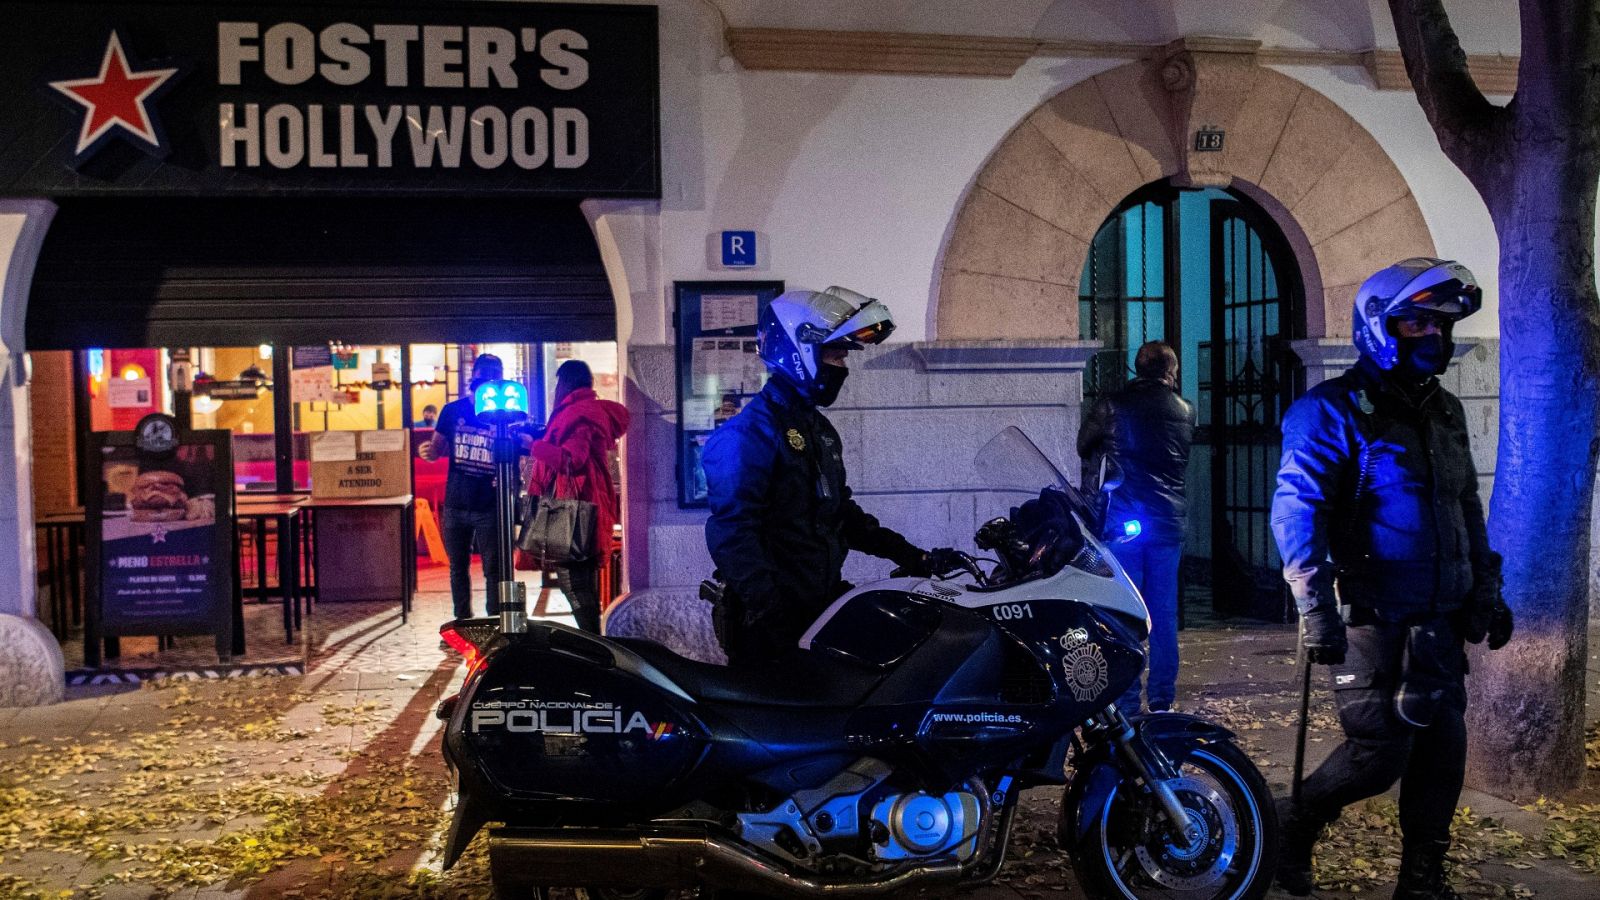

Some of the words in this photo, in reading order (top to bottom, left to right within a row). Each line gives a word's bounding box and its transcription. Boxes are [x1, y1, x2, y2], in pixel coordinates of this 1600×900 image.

[218, 21, 590, 91] FOSTER'S
[219, 103, 590, 170] HOLLYWOOD
[1201, 134, 1221, 148] 13
[731, 235, 746, 255] R
[792, 352, 805, 381] CNP
[347, 465, 353, 475] A
[355, 465, 373, 475] SER
[338, 479, 382, 488] ATENDIDO
[916, 589, 956, 602] HONDA
[472, 701, 526, 710] CUERPO
[529, 701, 593, 709] NACIONAL
[595, 702, 614, 710] DE
[472, 705, 653, 734] POLICÍA
[933, 712, 1022, 723] www.policia.es
